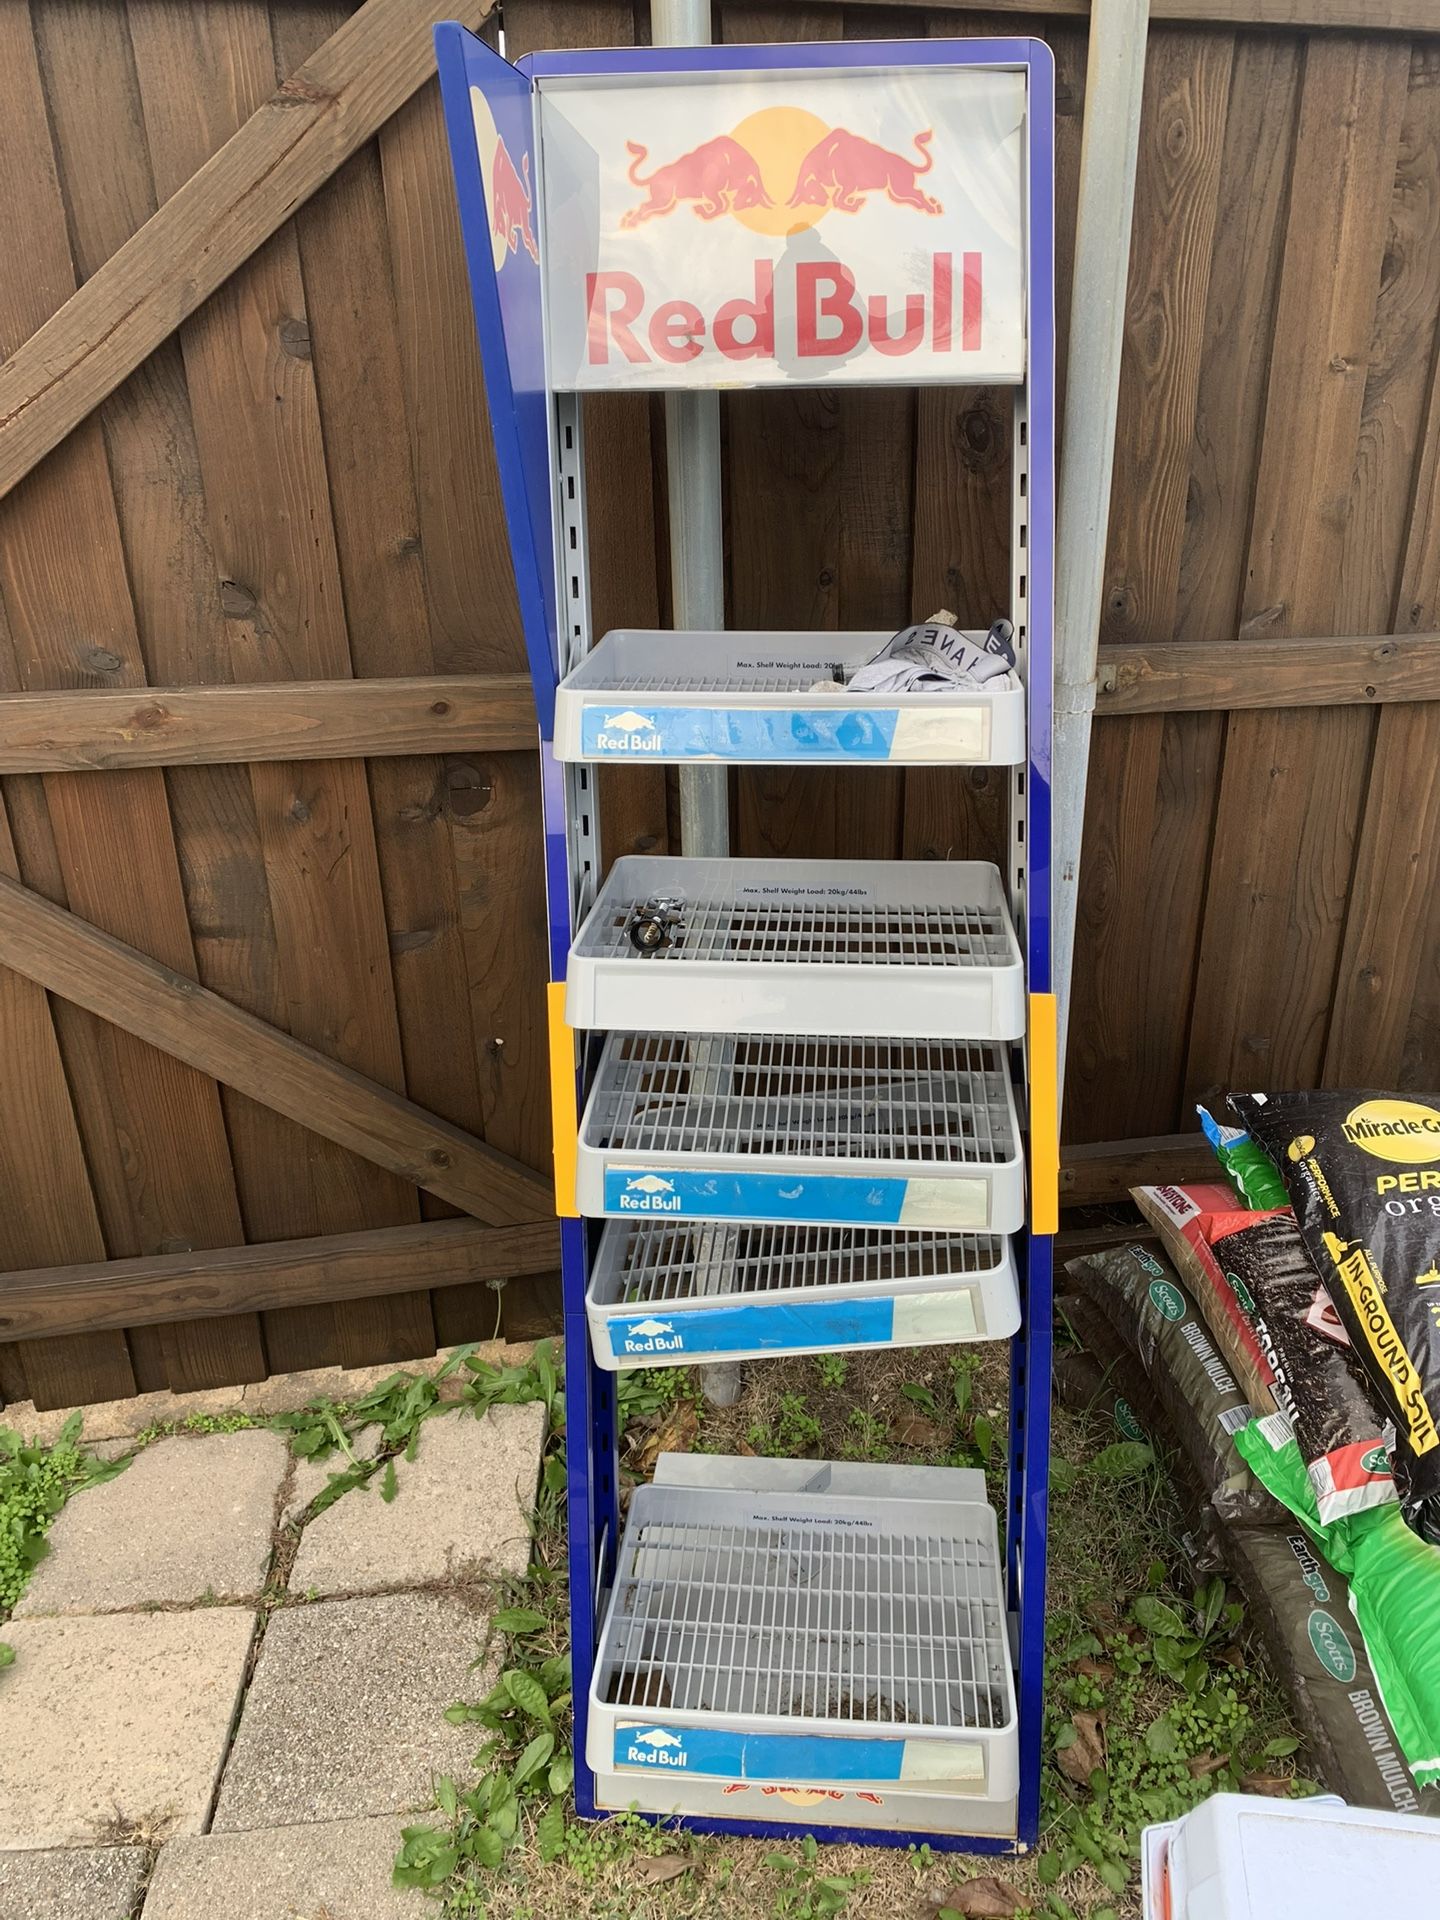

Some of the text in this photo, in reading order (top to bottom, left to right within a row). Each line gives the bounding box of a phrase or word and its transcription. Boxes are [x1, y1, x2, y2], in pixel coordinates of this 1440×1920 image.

[585, 251, 983, 366] Red Bull
[776, 662, 801, 670] Weight
[597, 733, 662, 751] Red Bull
[780, 887, 805, 896] Weight
[620, 1194, 681, 1211] Red Bull
[1307, 1158, 1341, 1218] PERFORMANCE
[1363, 1249, 1388, 1295] ALL PURPOSE
[1154, 1284, 1181, 1316] Scotts
[1347, 1256, 1410, 1385] IN-GROUND
[624, 1335, 684, 1352] Red Bull
[1180, 1321, 1237, 1395] BROWN MULCH
[1278, 1347, 1295, 1384] PREMIUM
[789, 1516, 813, 1524] Weight
[1288, 1535, 1330, 1602] Earthgro
[1314, 1620, 1348, 1673] Scotts
[627, 1746, 688, 1767] Red Bull
[1348, 1689, 1420, 1814] BROWN MULCH
